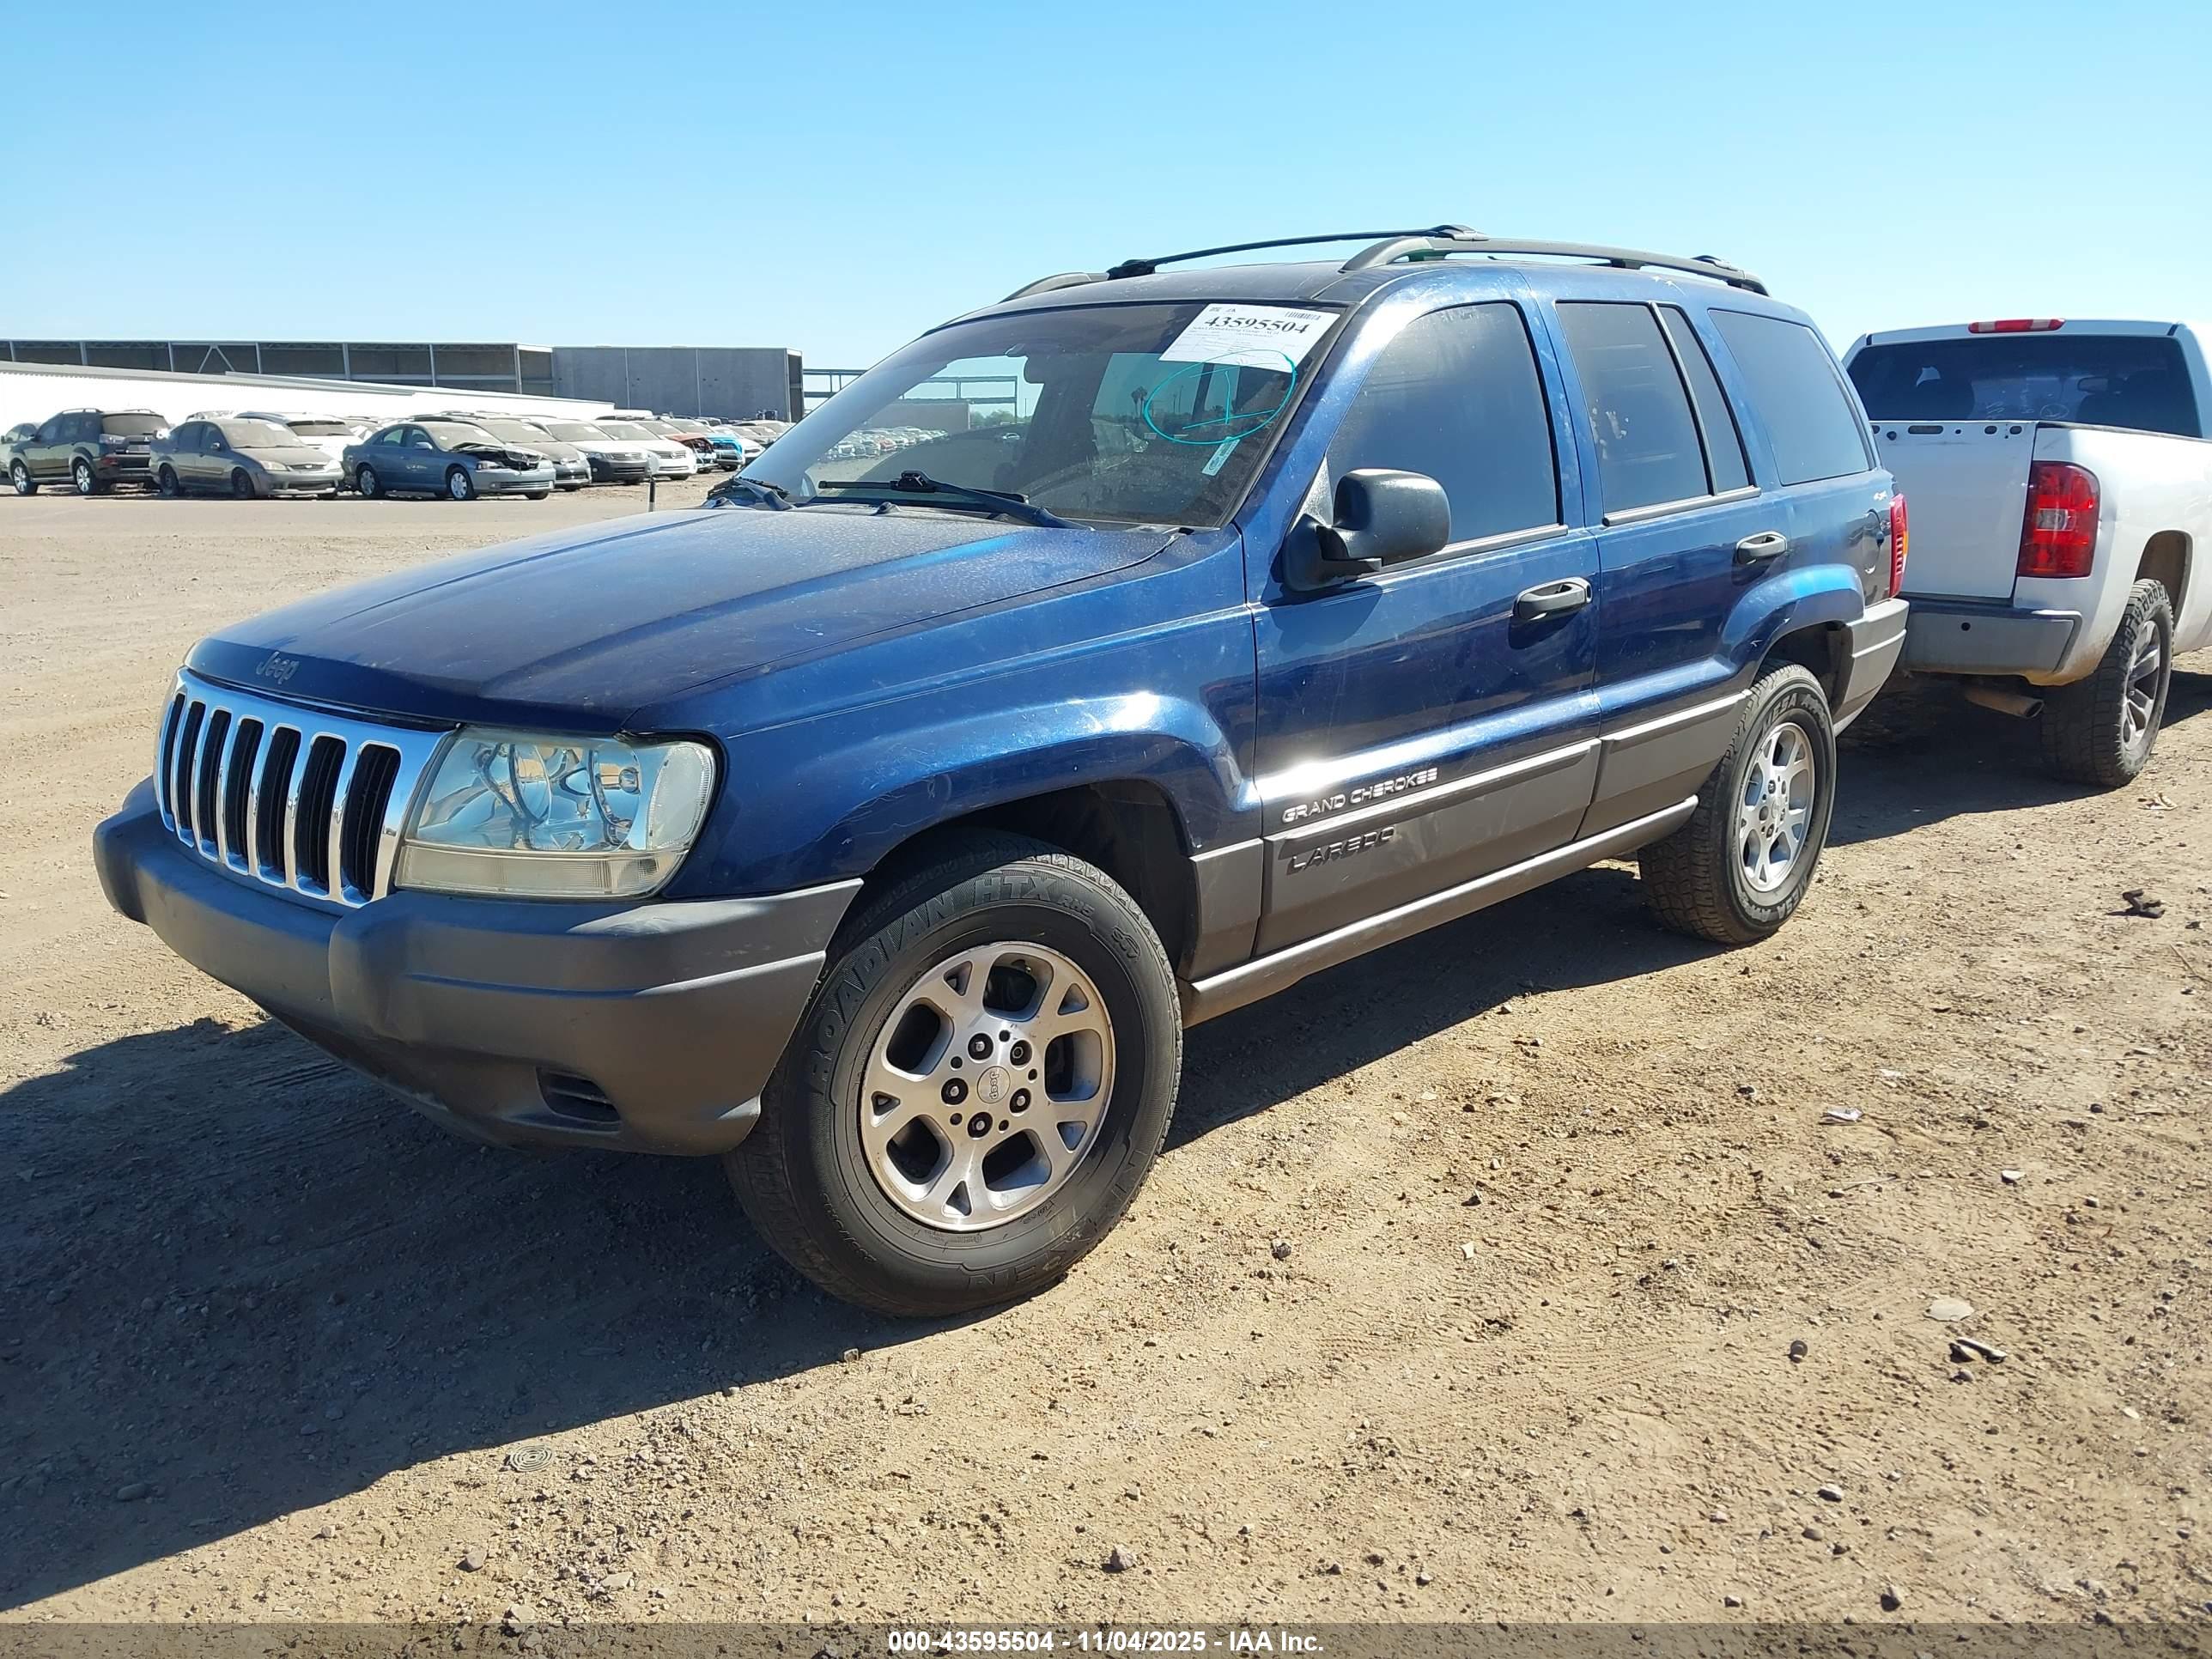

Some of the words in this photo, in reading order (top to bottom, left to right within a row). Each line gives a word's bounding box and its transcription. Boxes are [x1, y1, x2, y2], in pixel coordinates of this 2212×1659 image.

[1204, 315, 1310, 335] 43595504
[255, 651, 300, 684] Jeep
[1282, 793, 1346, 823] GRAND
[1349, 767, 1438, 805] CHEROKEE
[1286, 826, 1395, 876] LAREDO
[810, 890, 956, 1093] ROADIAN
[972, 874, 1056, 908] HTX
[988, 1071, 1000, 1100] Jeep
